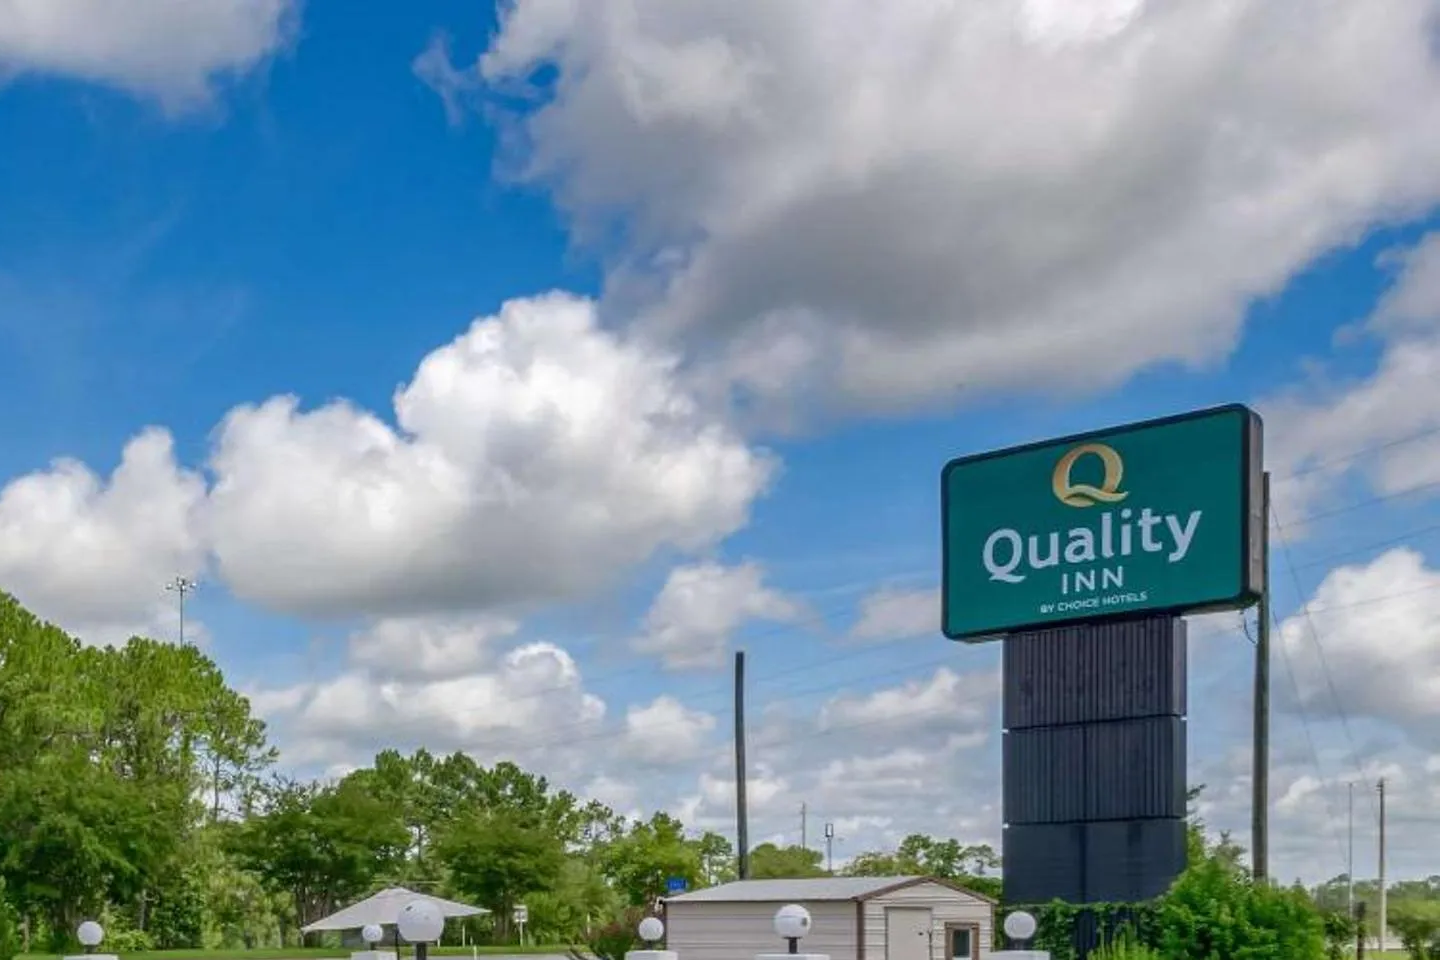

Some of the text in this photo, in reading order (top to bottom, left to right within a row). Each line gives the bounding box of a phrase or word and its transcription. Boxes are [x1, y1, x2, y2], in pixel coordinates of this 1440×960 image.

[1052, 443, 1129, 508] Q
[983, 508, 1203, 584] Quality
[1040, 590, 1148, 614] BY CHOICE HOTELS
[1062, 566, 1124, 594] INN
